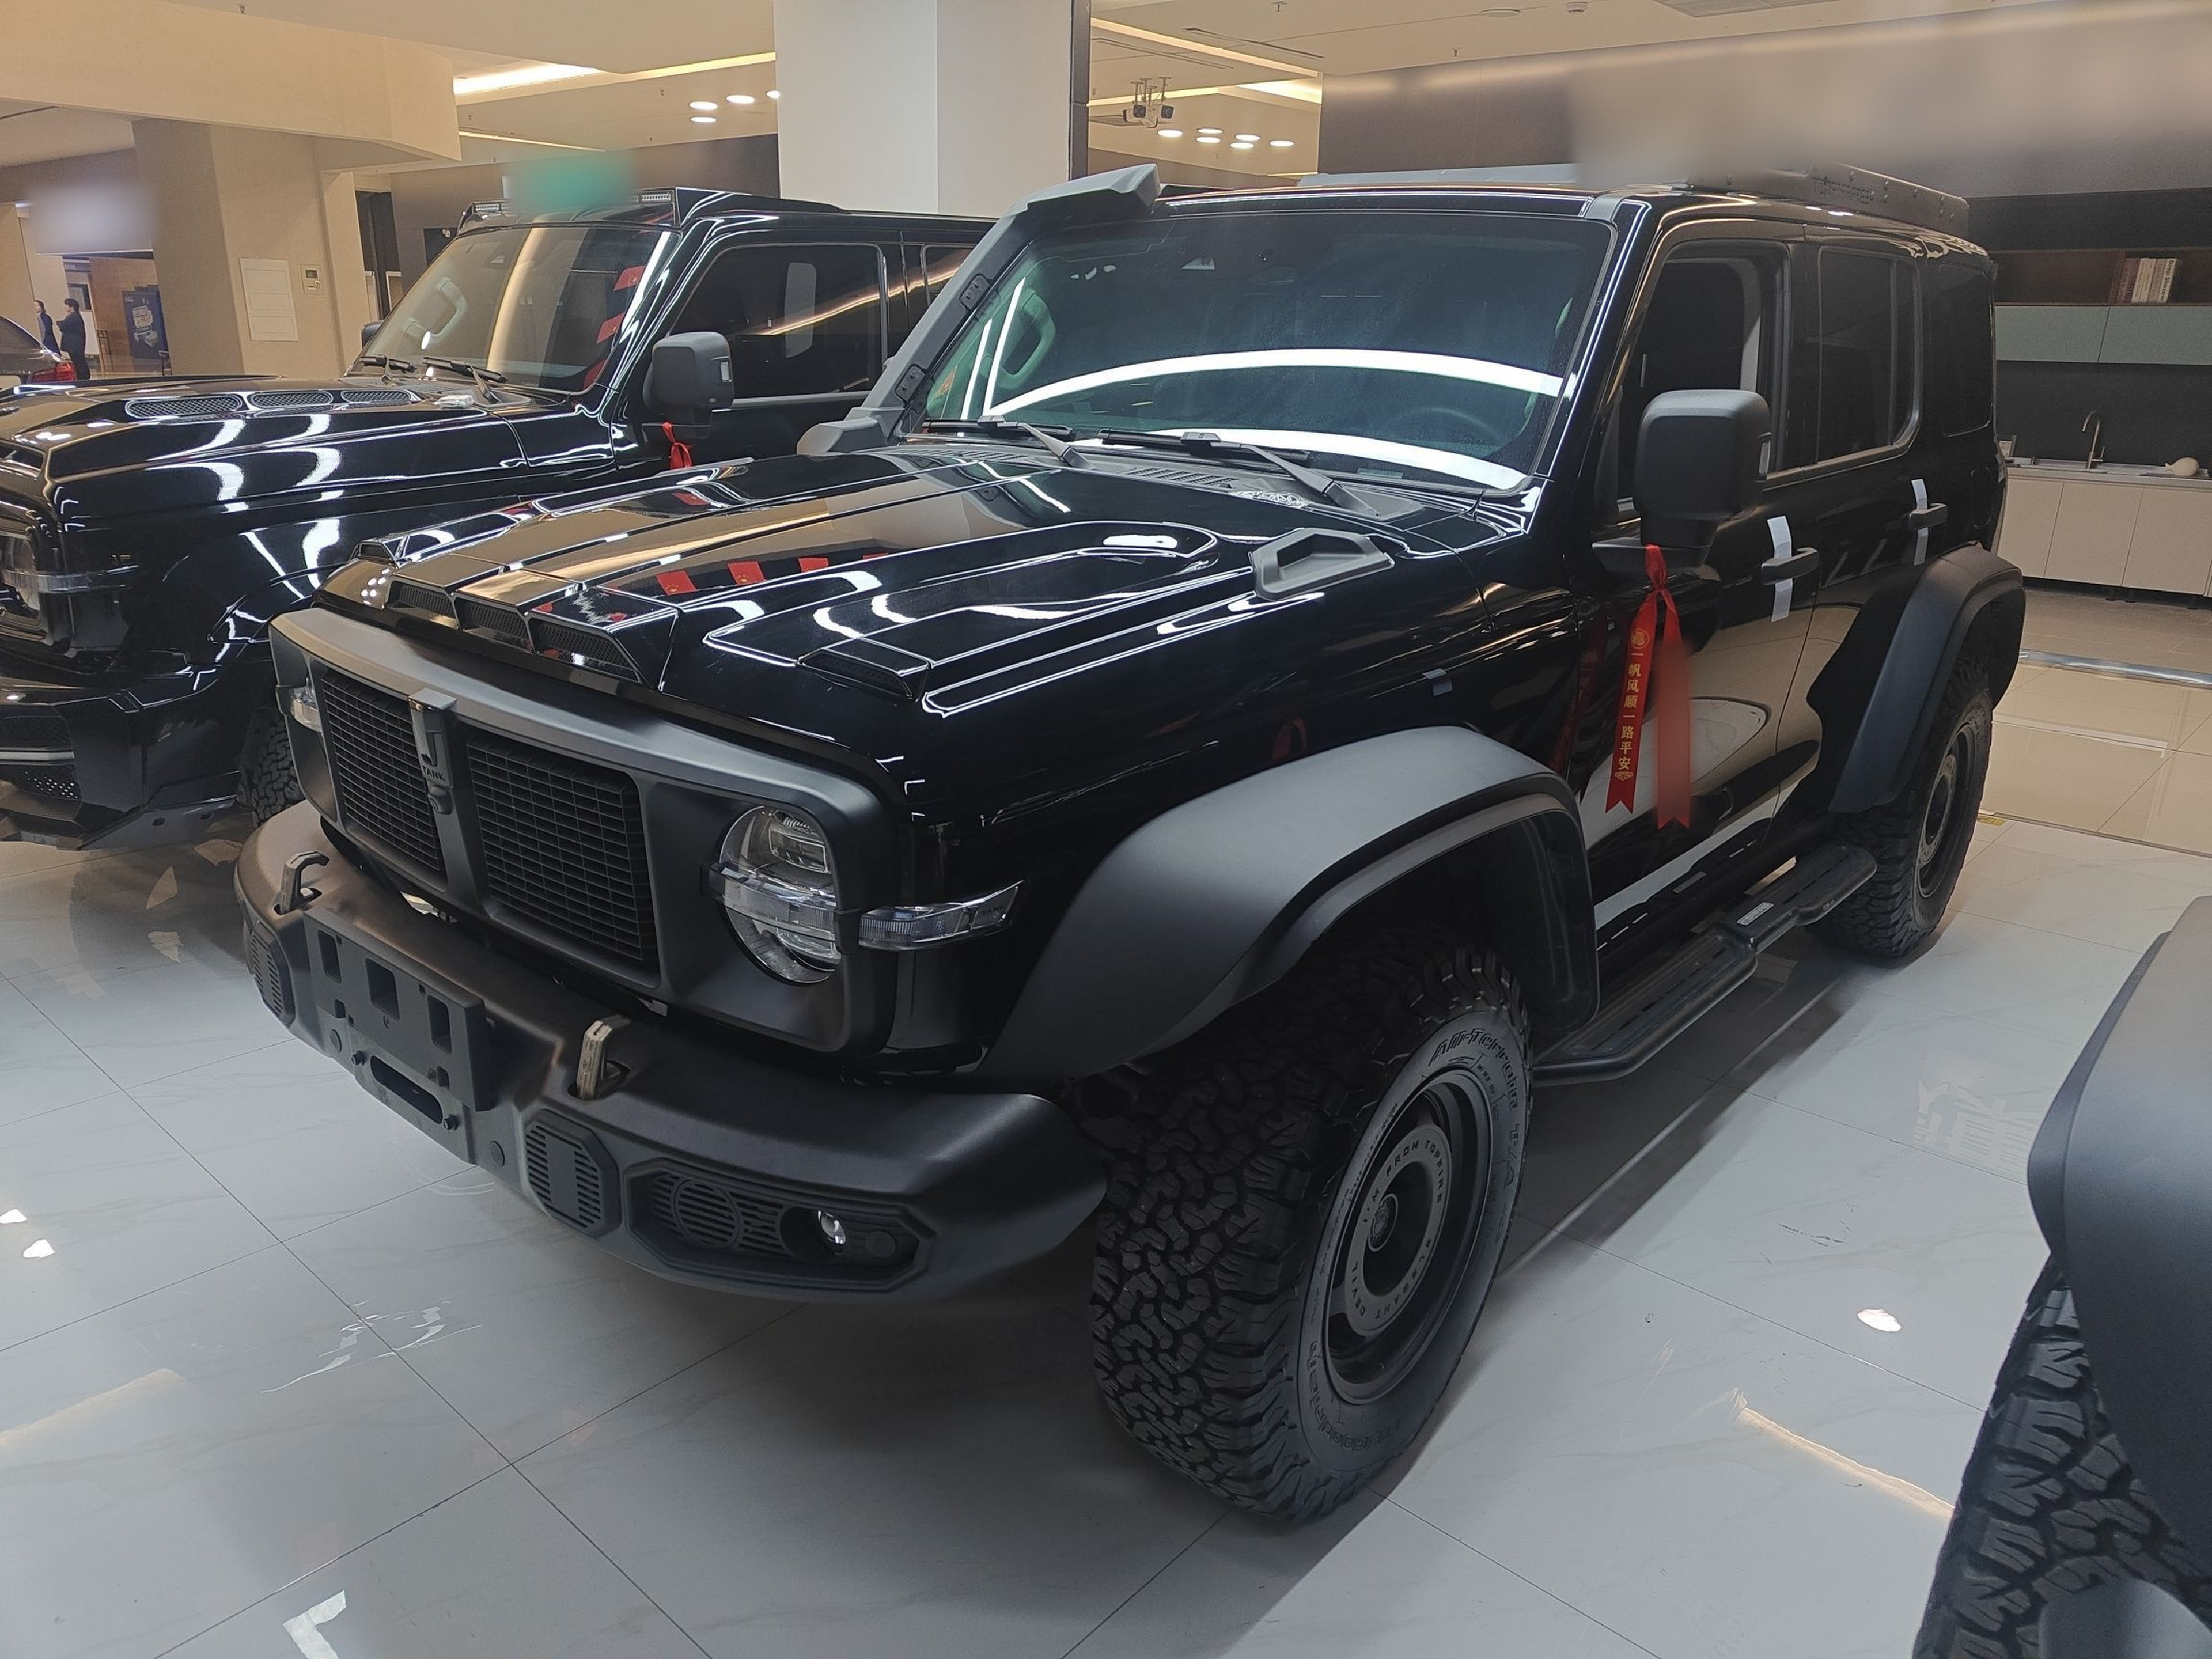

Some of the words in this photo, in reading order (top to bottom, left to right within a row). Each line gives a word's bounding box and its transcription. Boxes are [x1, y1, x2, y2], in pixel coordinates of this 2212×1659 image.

[1618, 652, 1644, 771] 一帆风顺一路平安
[422, 766, 446, 782] TANK
